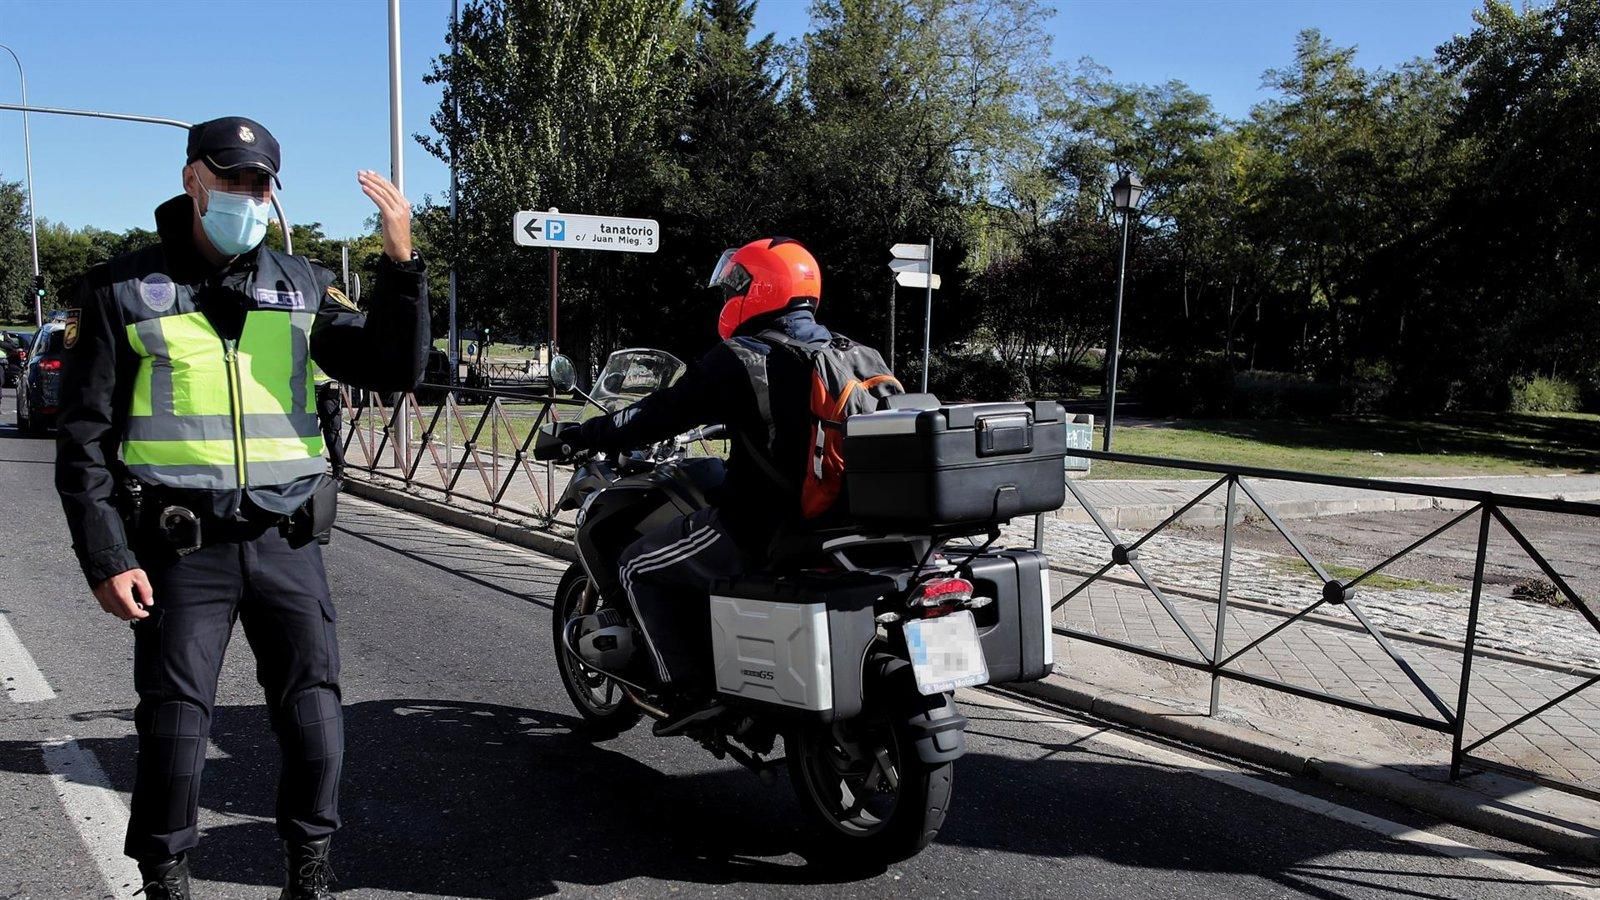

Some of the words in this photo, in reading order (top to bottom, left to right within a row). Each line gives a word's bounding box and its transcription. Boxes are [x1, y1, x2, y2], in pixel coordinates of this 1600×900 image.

[549, 221, 563, 239] P
[600, 223, 653, 236] tanatorio
[575, 233, 587, 242] c/
[592, 235, 613, 243] Juan
[647, 237, 653, 246] 3
